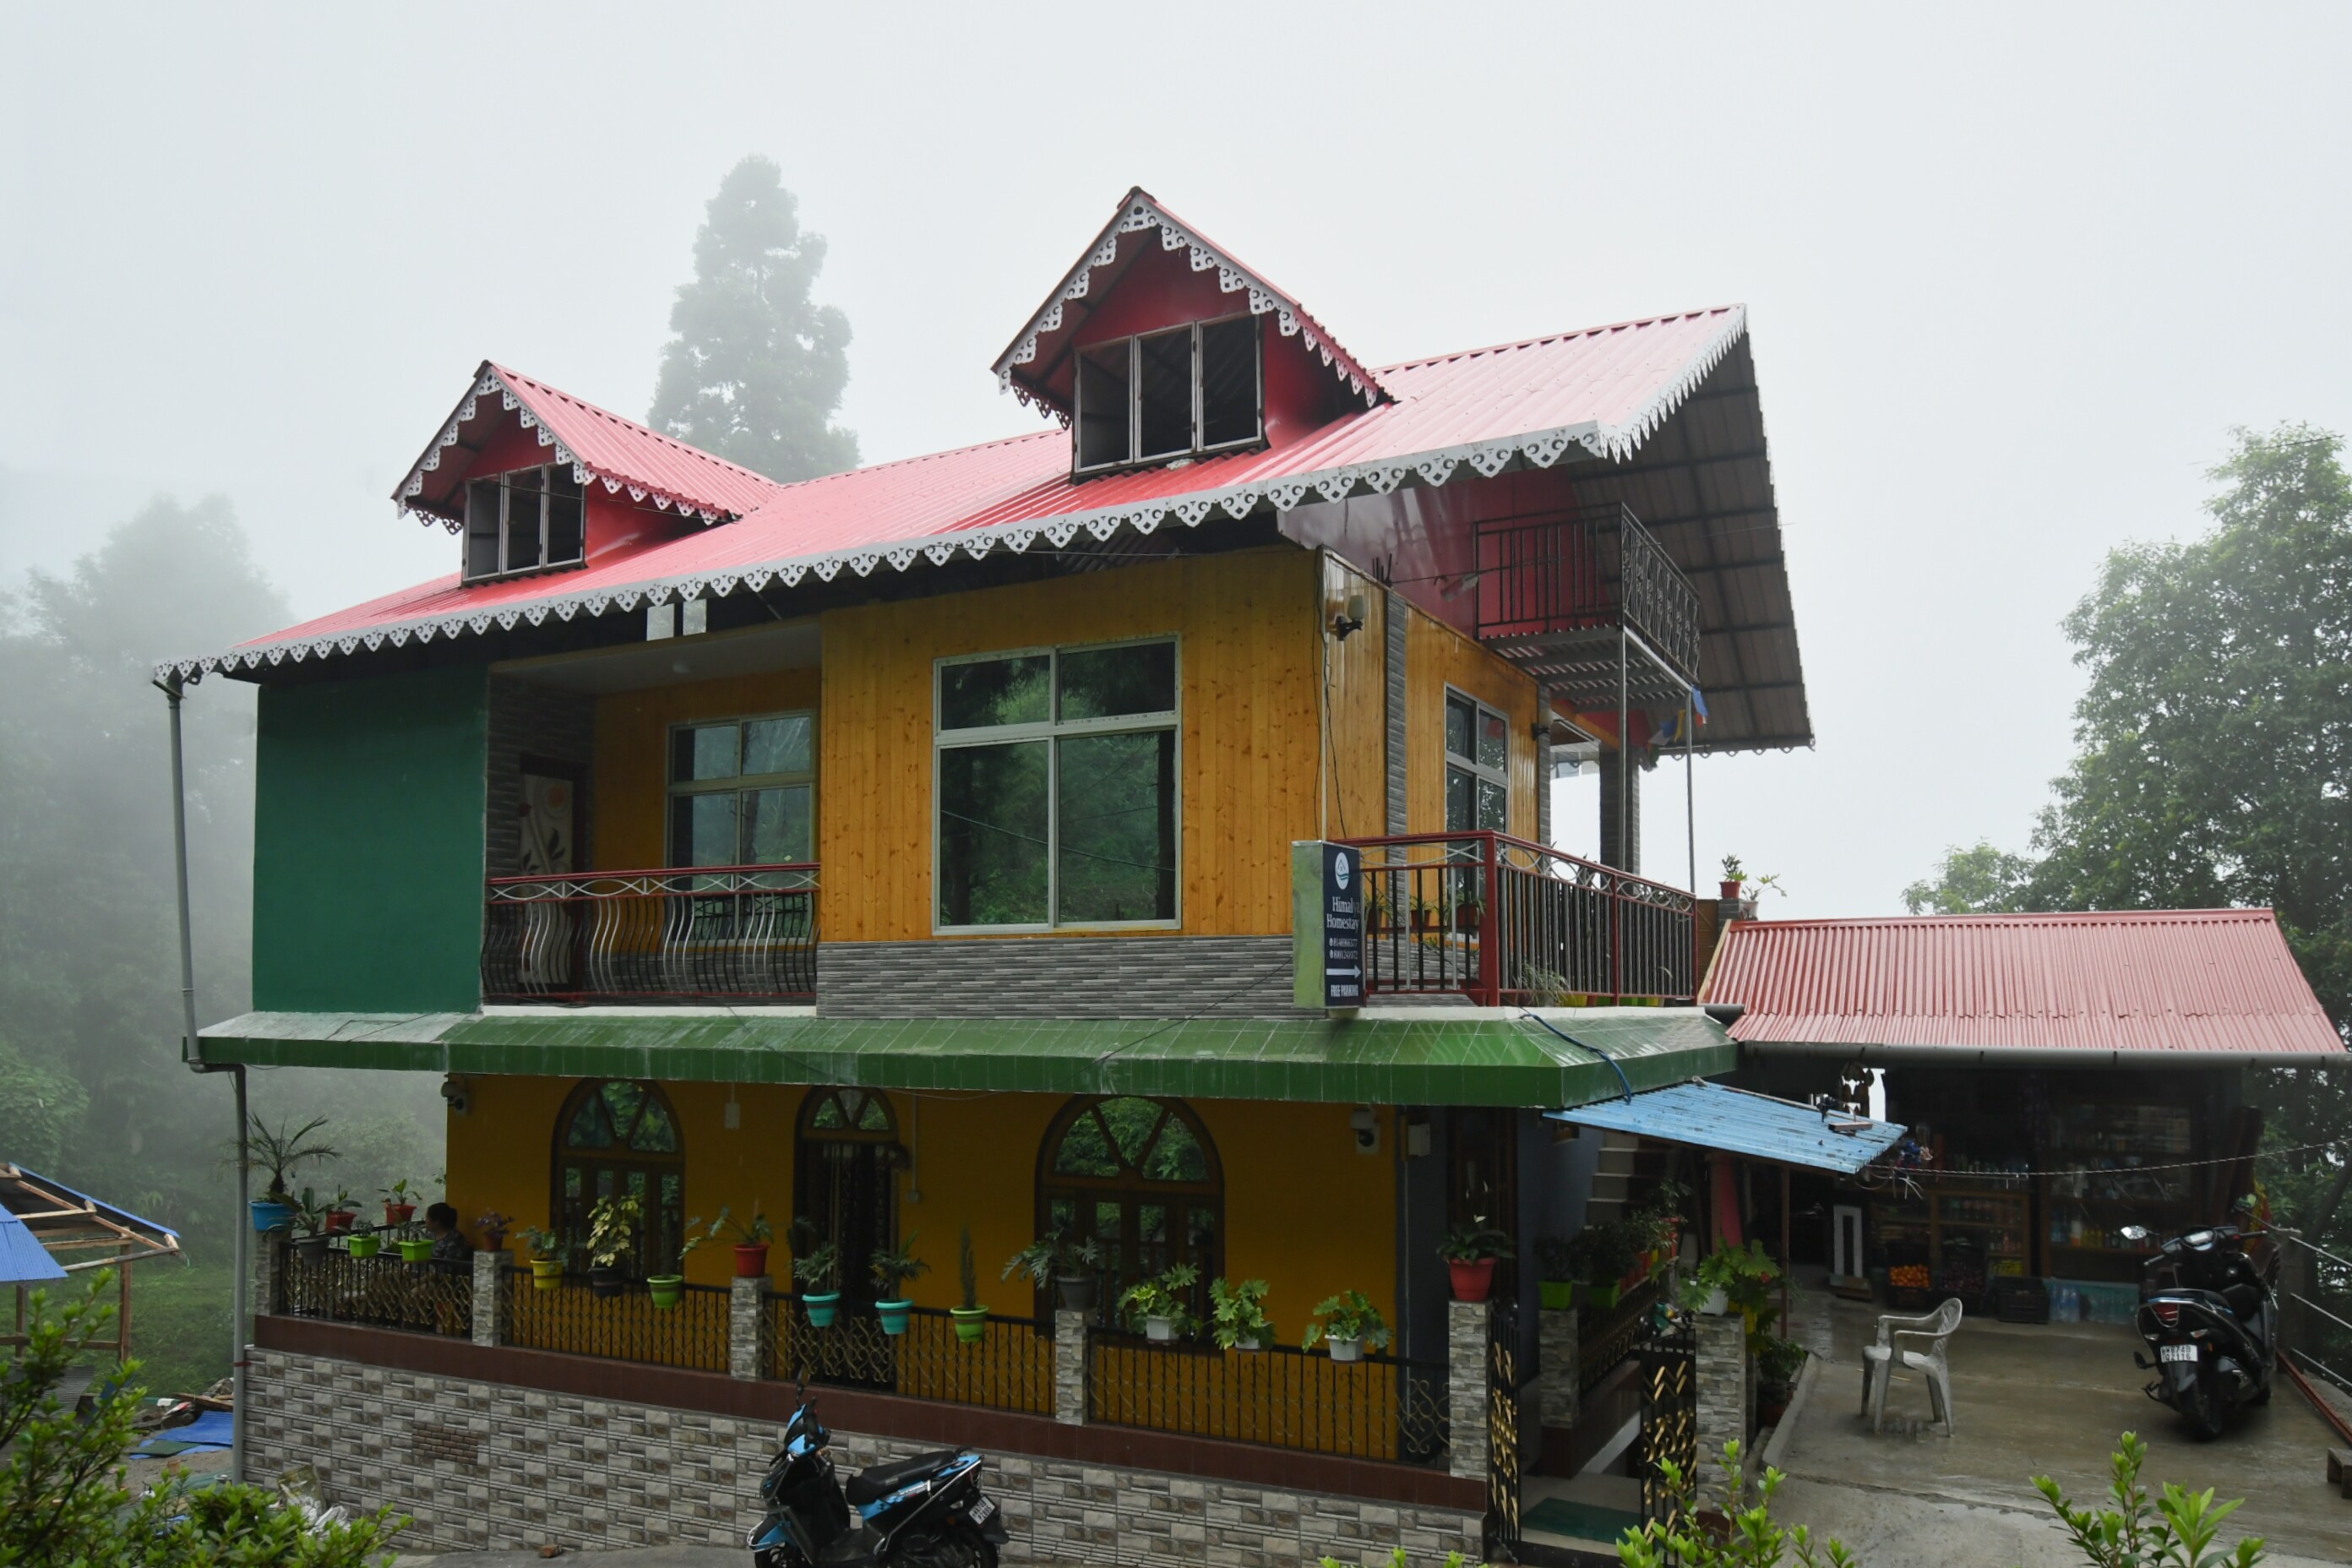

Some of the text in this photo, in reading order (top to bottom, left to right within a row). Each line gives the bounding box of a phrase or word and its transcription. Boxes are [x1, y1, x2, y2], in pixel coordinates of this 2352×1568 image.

[1326, 913, 1360, 934] Homestay
[1331, 984, 1358, 997] FREE PARKING
